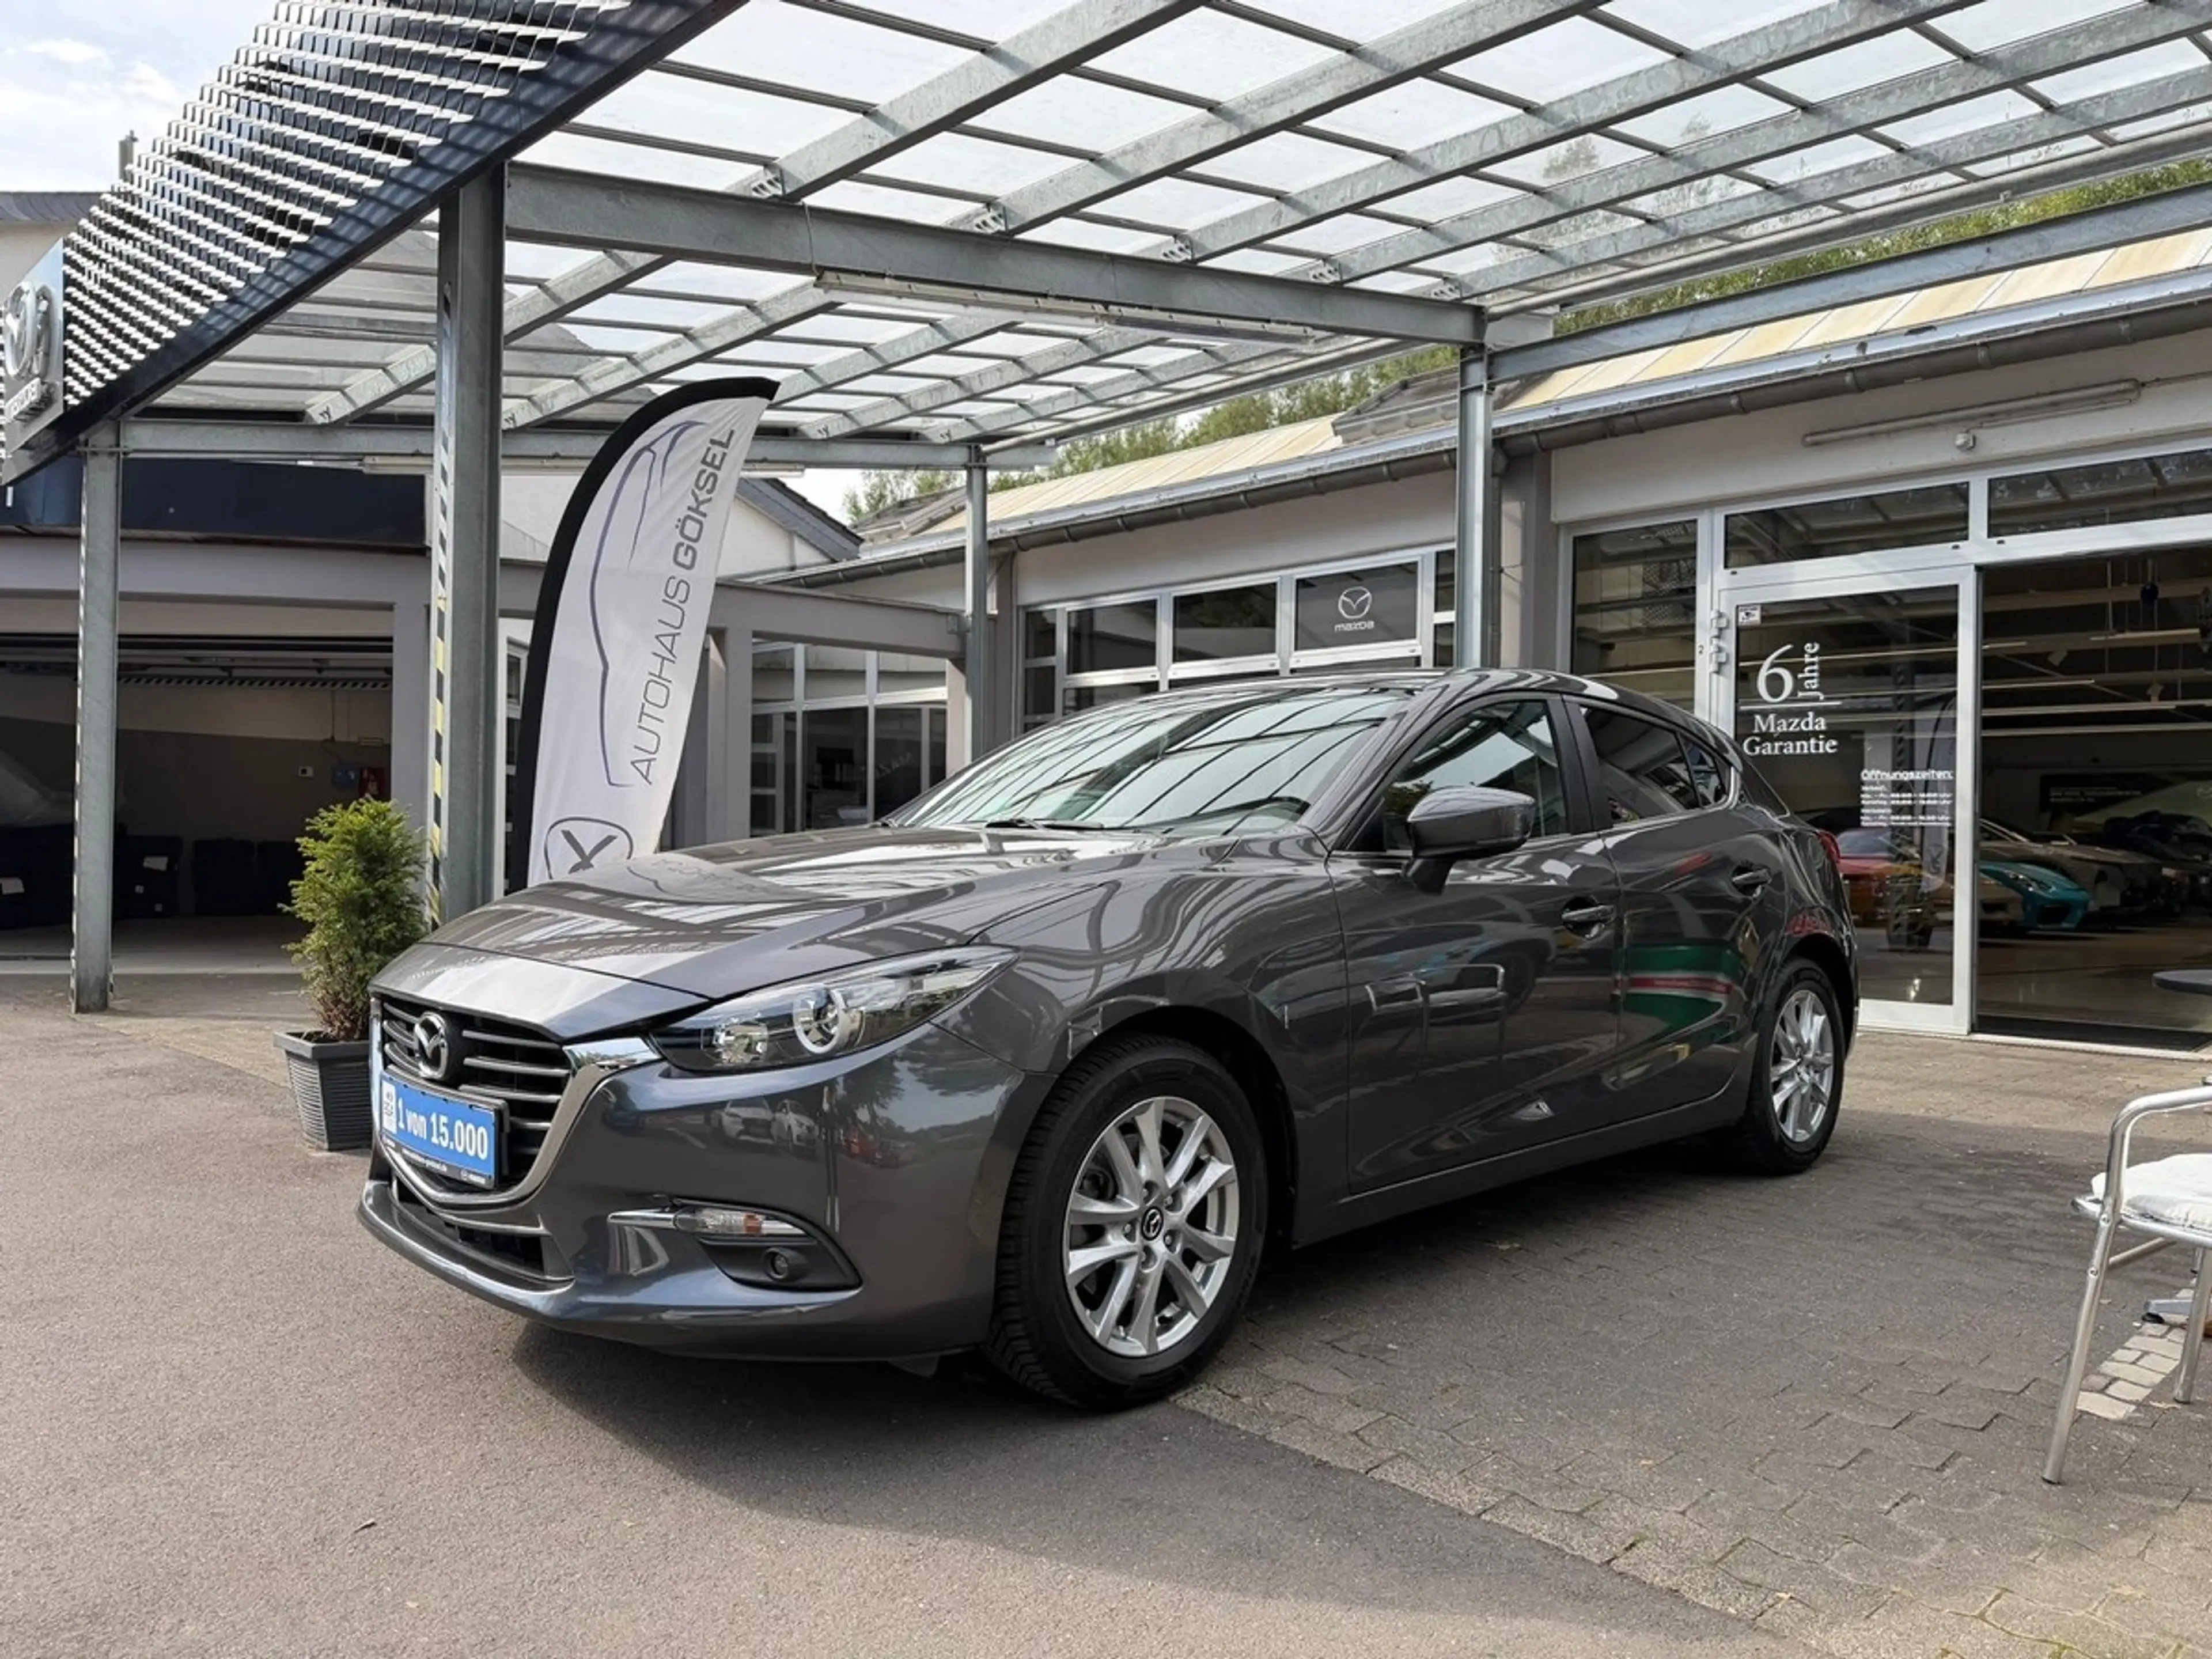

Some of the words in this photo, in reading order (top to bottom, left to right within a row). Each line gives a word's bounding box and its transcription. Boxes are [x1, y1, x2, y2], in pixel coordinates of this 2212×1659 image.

[630, 575, 691, 785] AUTOHAUS
[672, 429, 736, 571] GÖKSEL
[1757, 644, 1794, 703] 6
[1797, 641, 1824, 700] Jahre
[1743, 734, 1838, 756] Garantie
[1753, 712, 1827, 733] Mazda
[398, 1097, 404, 1129] 1
[406, 1108, 426, 1140] von
[430, 1112, 488, 1160] 15.000
